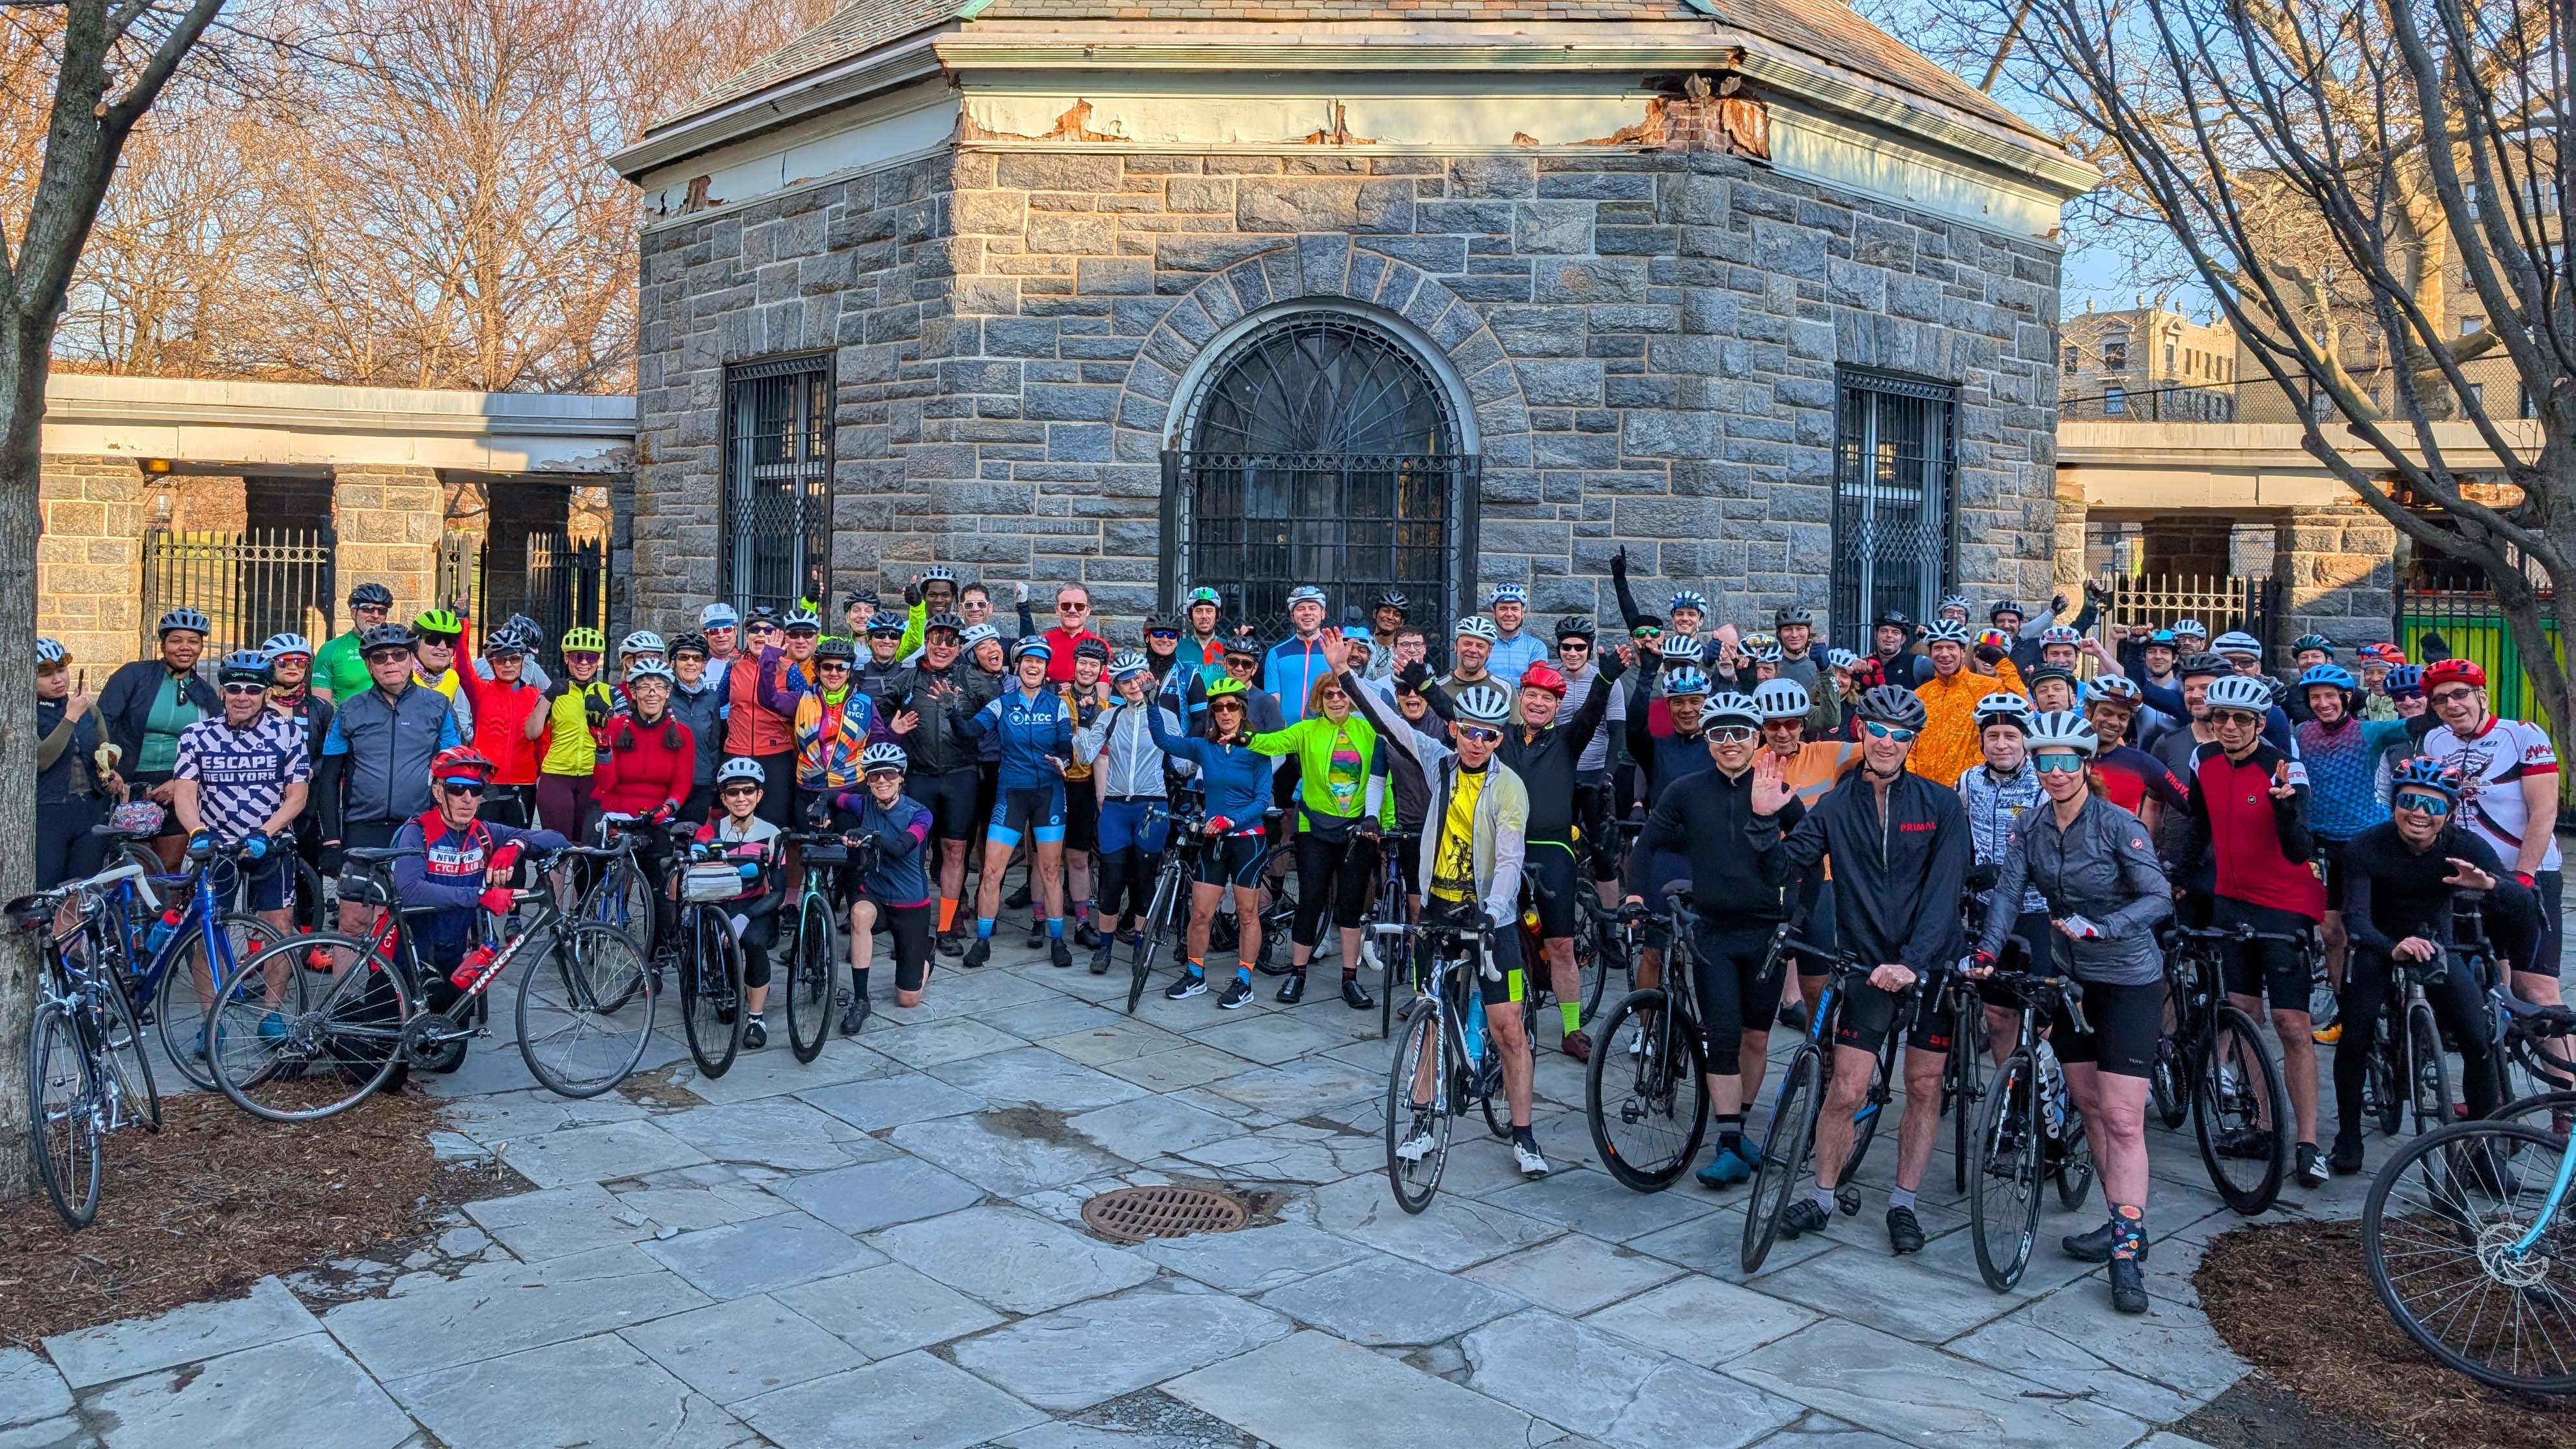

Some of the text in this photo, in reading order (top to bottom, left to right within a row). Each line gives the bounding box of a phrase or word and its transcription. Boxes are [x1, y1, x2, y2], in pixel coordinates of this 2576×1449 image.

[847, 710, 864, 719] NYCC
[1024, 712, 1052, 722] NYCC
[201, 755, 277, 770] ESCAPE
[237, 771, 276, 781] YORK
[1900, 821, 1937, 832] PRIMAL
[436, 853, 456, 863] NEW
[435, 864, 460, 873] CYCLE
[468, 934, 525, 995] TIRRENO
[1812, 989, 1831, 1040] GIANT
